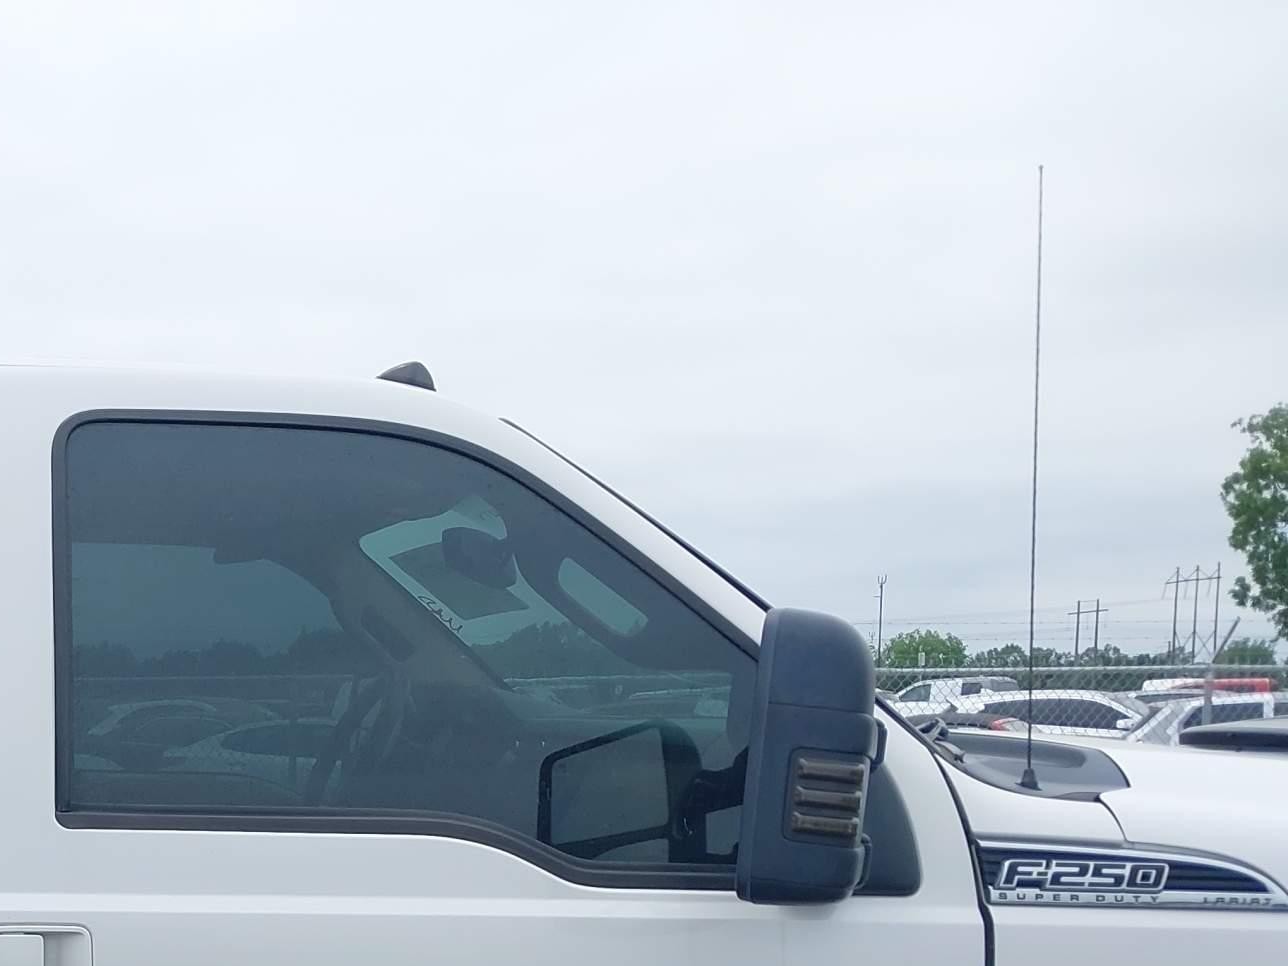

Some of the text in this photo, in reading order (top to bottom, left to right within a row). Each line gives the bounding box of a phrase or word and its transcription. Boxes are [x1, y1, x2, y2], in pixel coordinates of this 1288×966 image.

[999, 859, 1169, 890] F-250
[997, 891, 1161, 904] SUPER DUTY
